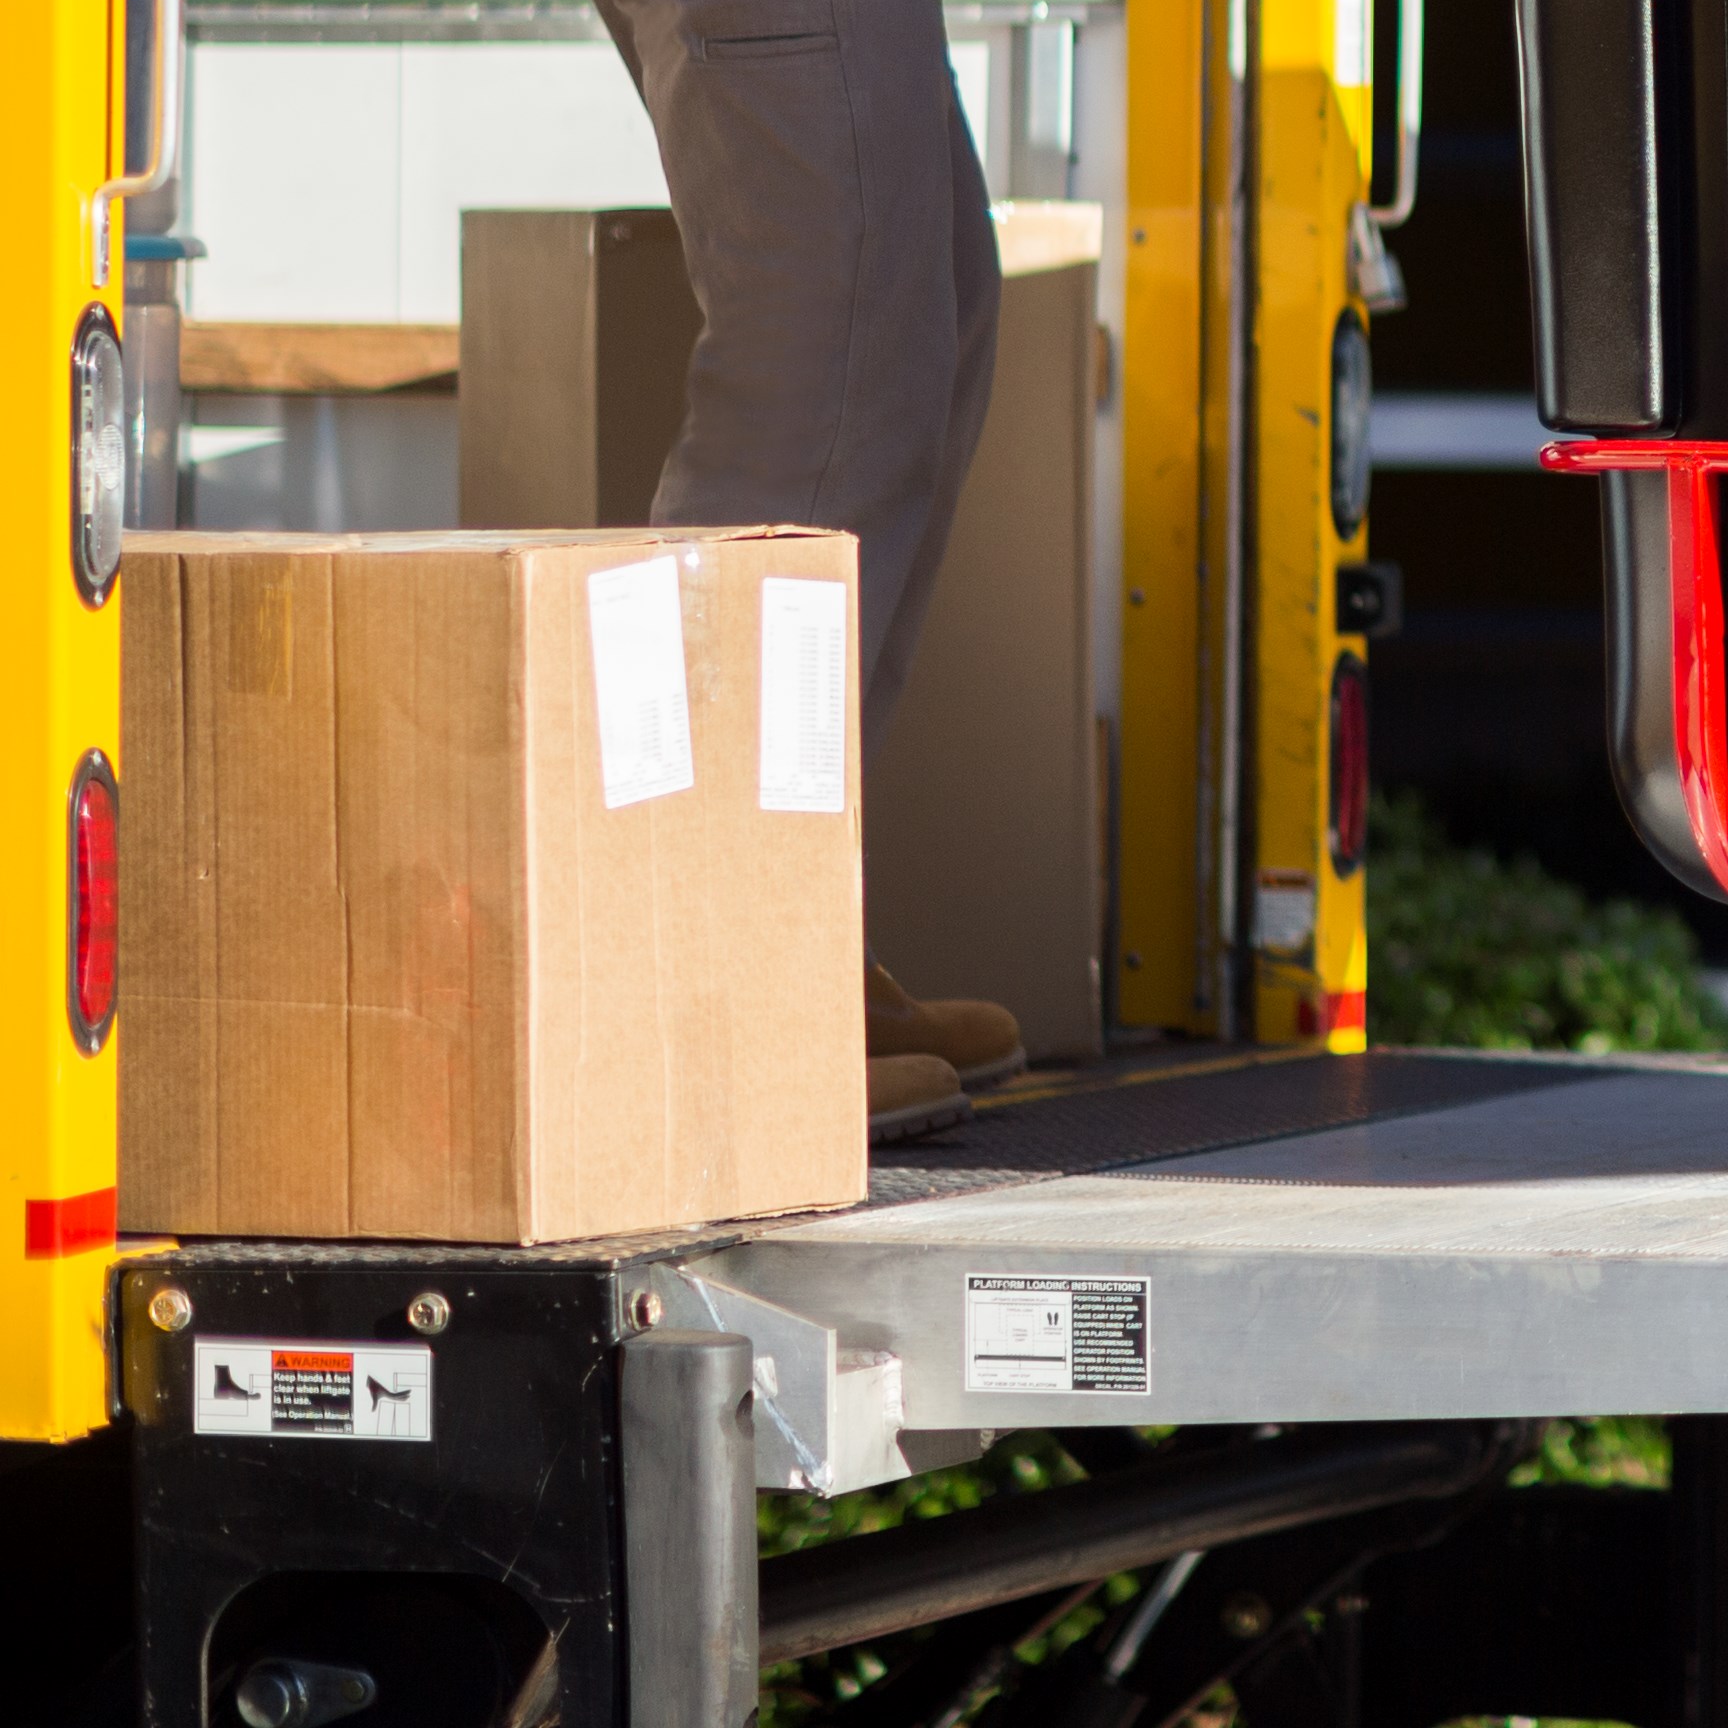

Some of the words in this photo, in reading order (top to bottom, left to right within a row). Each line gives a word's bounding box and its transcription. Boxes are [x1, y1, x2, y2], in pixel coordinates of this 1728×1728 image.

[974, 1279, 1025, 1290] PLATFORM
[1026, 1280, 1070, 1291] LOADING
[1071, 1281, 1142, 1293] INSTRUCTIONS
[290, 1356, 350, 1369] WARNING
[273, 1372, 296, 1383] Keep
[297, 1373, 323, 1383] hands
[325, 1373, 333, 1383] &
[334, 1373, 350, 1384] feet
[273, 1384, 294, 1393] clear
[296, 1385, 320, 1394] when
[321, 1385, 351, 1397] liftgate
[273, 1395, 282, 1404] is
[283, 1395, 292, 1404] in
[288, 1410, 323, 1420] Operation
